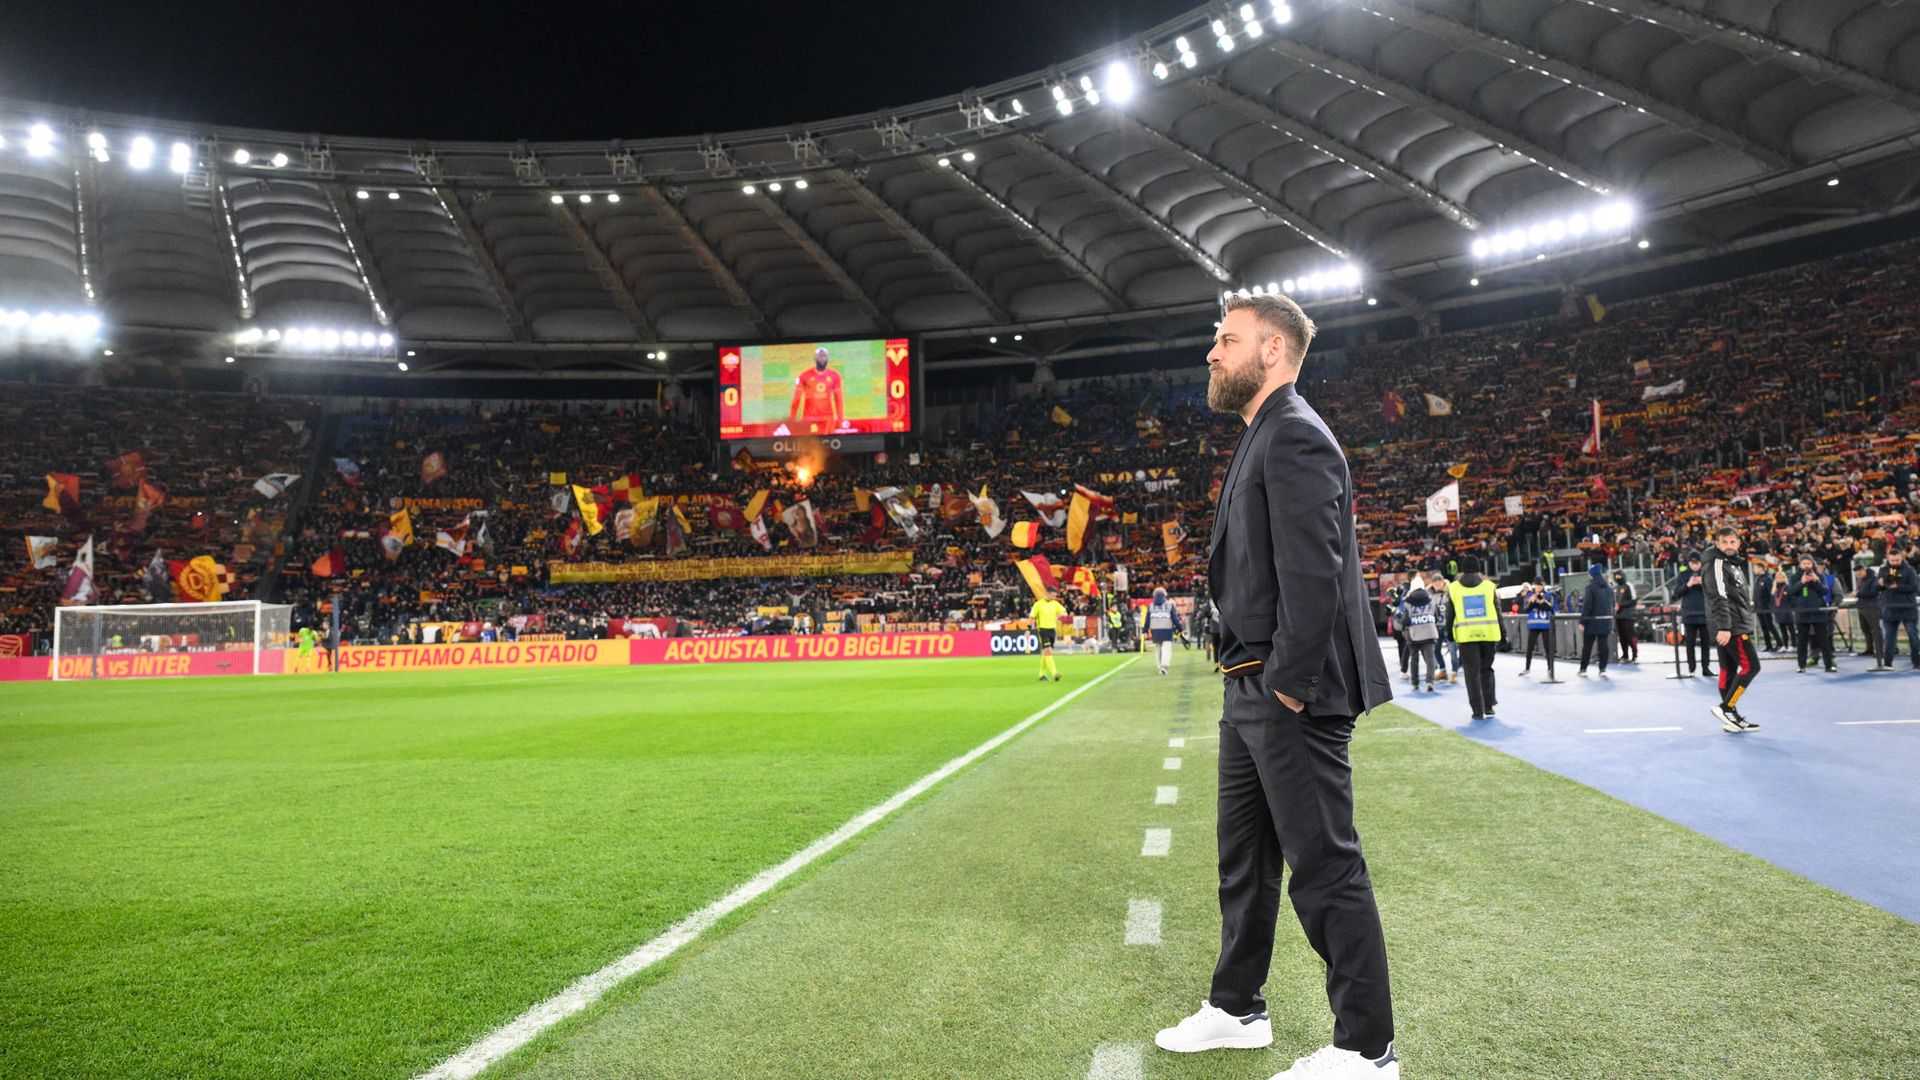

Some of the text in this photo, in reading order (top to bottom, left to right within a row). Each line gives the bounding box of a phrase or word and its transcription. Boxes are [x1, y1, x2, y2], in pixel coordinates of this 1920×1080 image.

[724, 387, 739, 406] 0
[890, 379, 905, 399] 0
[664, 634, 954, 663] ACQUISTA IL TUO BIGLIETTO
[990, 635, 1039, 653] 00:00
[108, 660, 129, 676] vs
[132, 655, 191, 675] INTER
[339, 647, 465, 668] ASPETTIAMO
[469, 645, 520, 665] ALLO
[525, 643, 598, 663] STADIO
